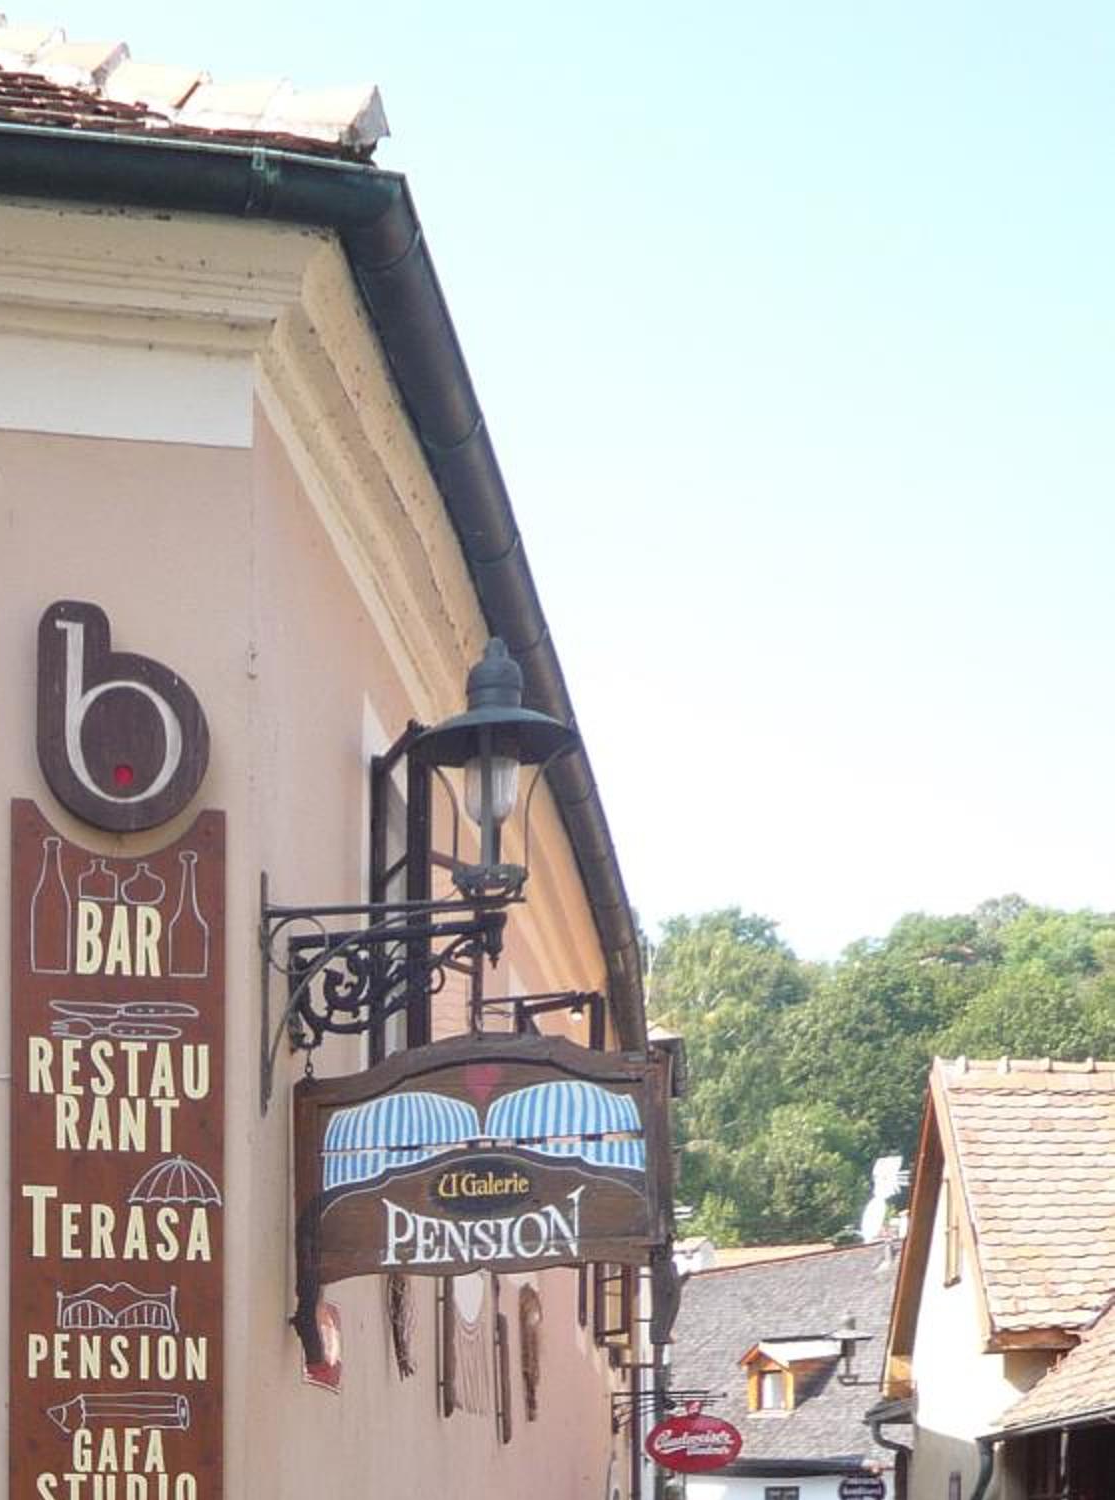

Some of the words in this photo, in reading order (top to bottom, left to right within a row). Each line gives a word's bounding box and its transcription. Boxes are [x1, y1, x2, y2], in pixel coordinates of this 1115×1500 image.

[75, 900, 162, 978] BAR
[28, 1036, 211, 1101] RESTAU
[56, 1093, 180, 1154] RANT
[461, 1171, 530, 1197] Galerie
[22, 1185, 212, 1262] TERASA
[380, 1185, 585, 1266] PENSION
[27, 1333, 208, 1381] PENSION
[72, 1427, 166, 1474] GAFA
